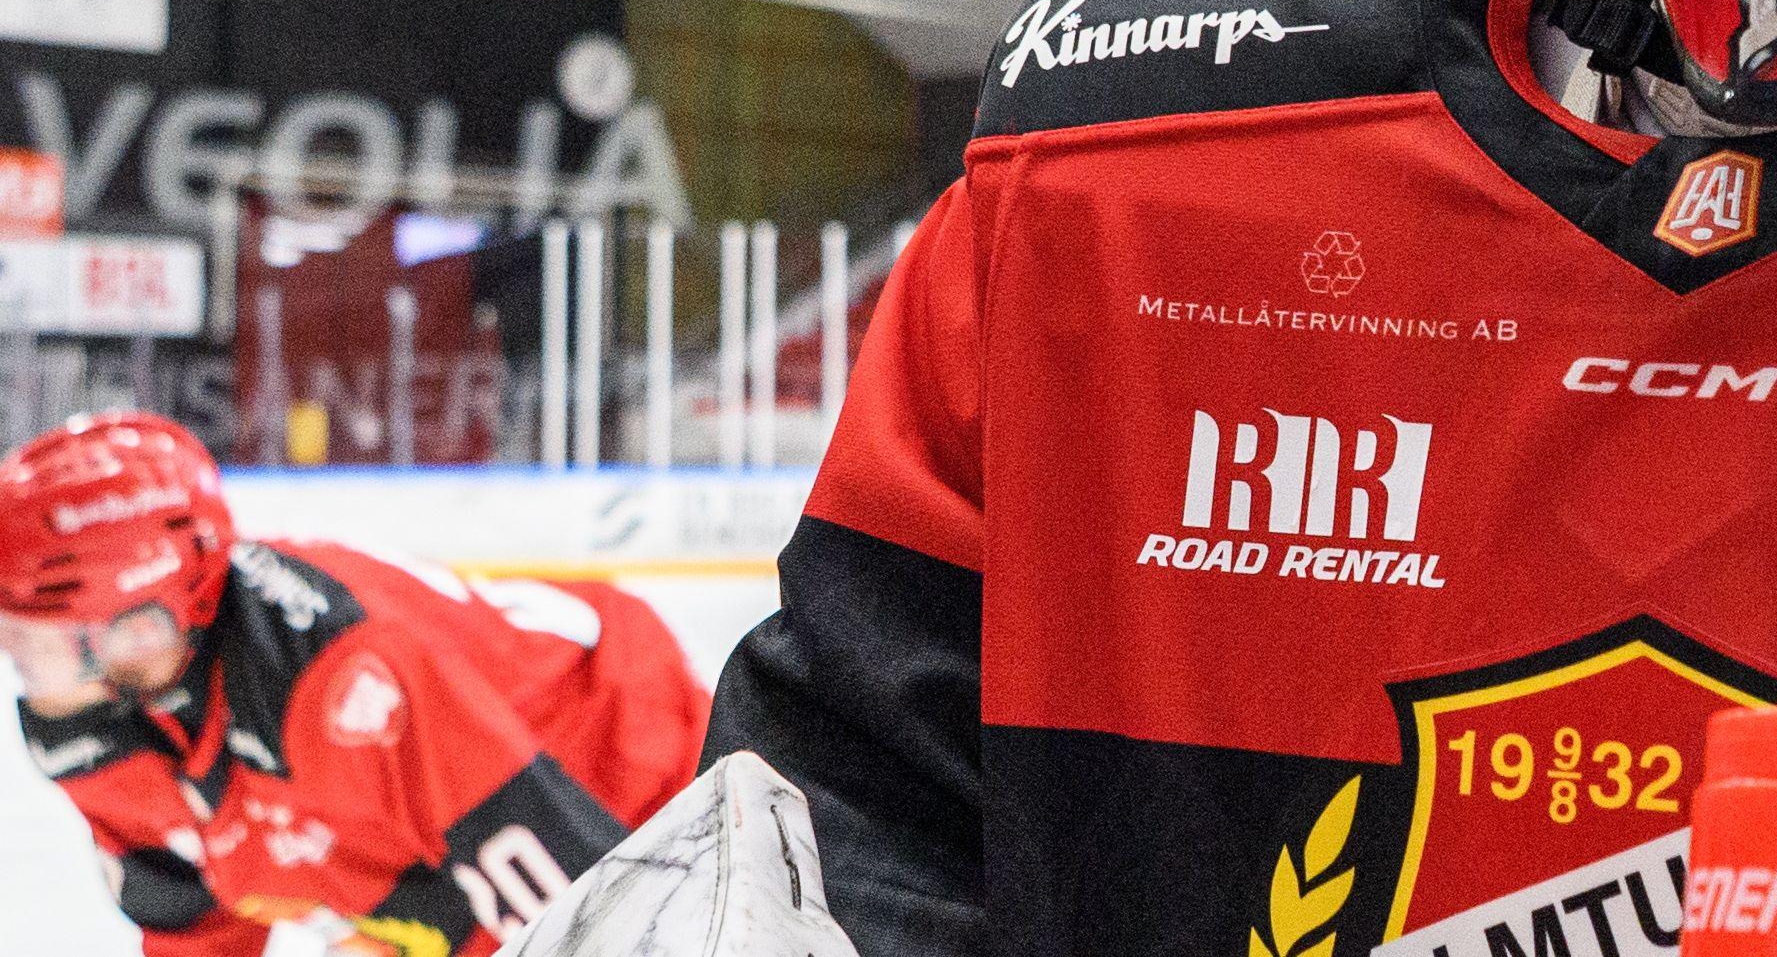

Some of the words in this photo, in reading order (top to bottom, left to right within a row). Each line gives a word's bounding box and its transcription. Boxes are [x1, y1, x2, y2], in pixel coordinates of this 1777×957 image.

[1471, 318, 1520, 342] AB
[1136, 533, 1270, 576] ROAD
[1278, 545, 1447, 589] RENTAL
